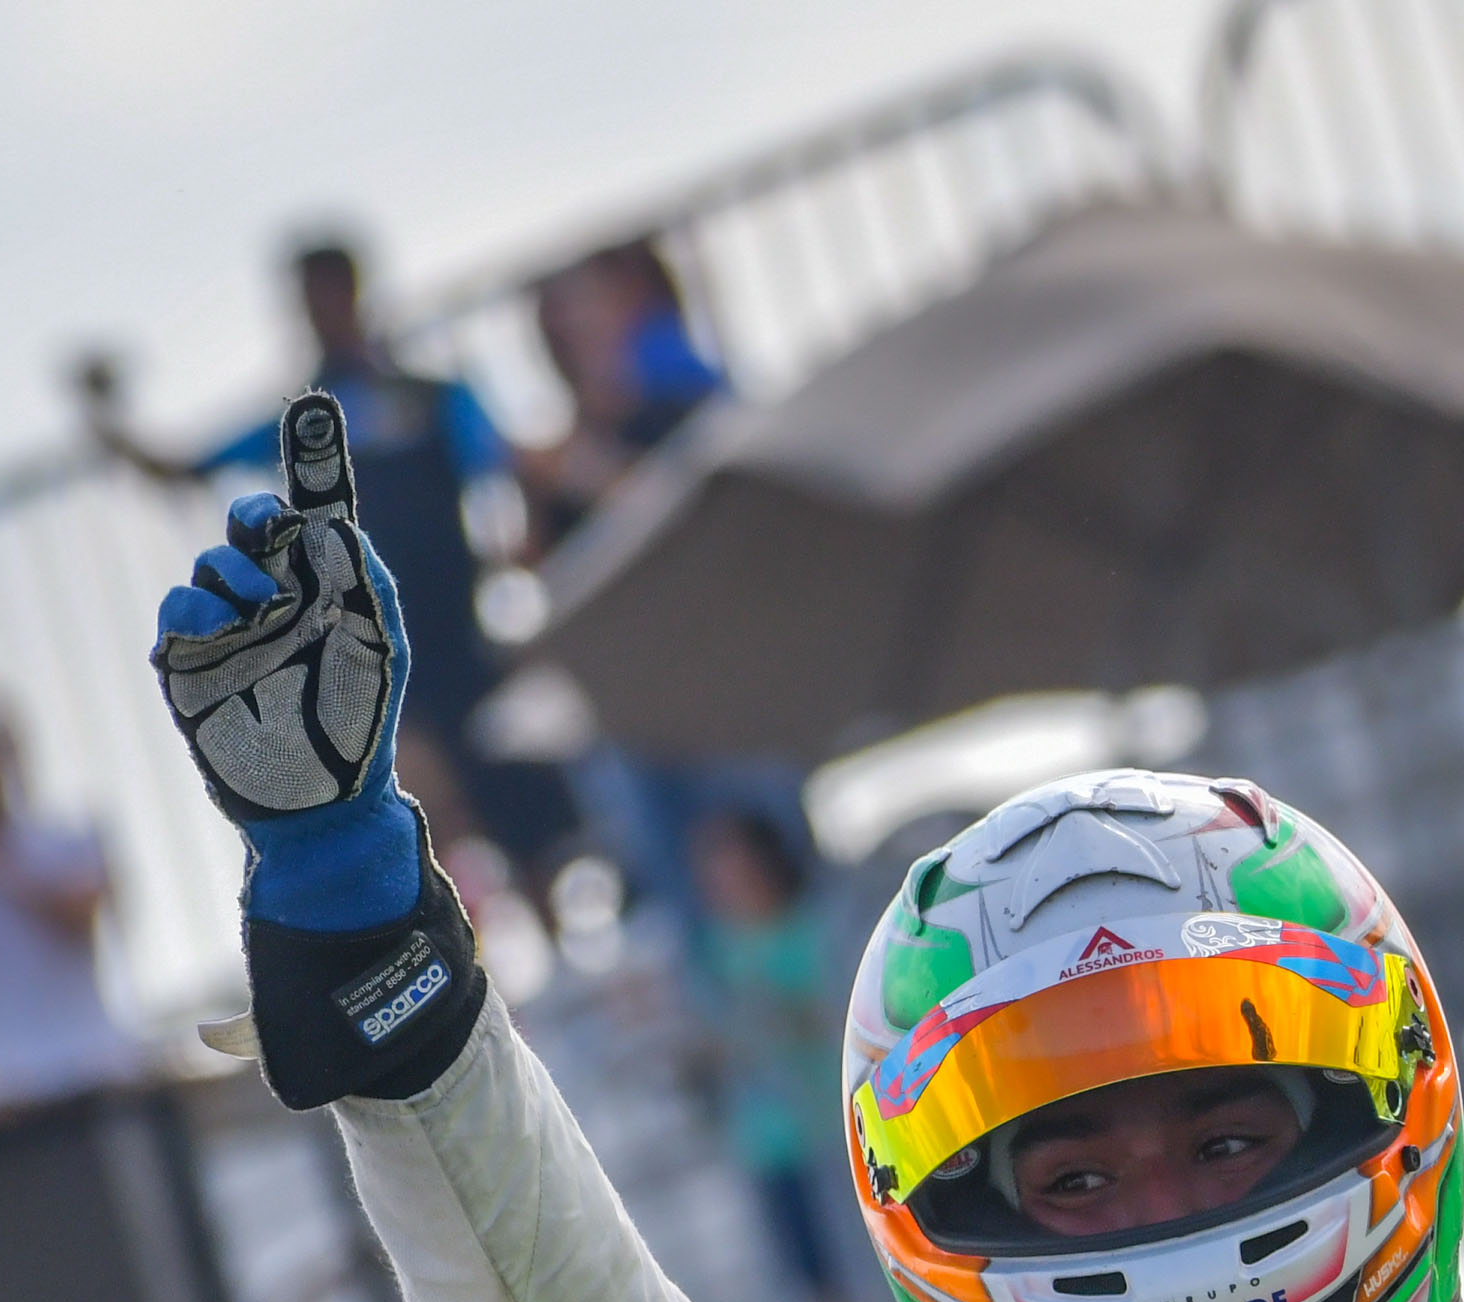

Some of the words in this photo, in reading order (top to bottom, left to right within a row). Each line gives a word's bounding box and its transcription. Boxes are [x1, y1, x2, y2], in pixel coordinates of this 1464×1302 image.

[394, 951, 412, 967] with
[412, 946, 431, 967] 2000
[1058, 948, 1165, 980] ALESSANDROS
[363, 965, 445, 1038] sparco
